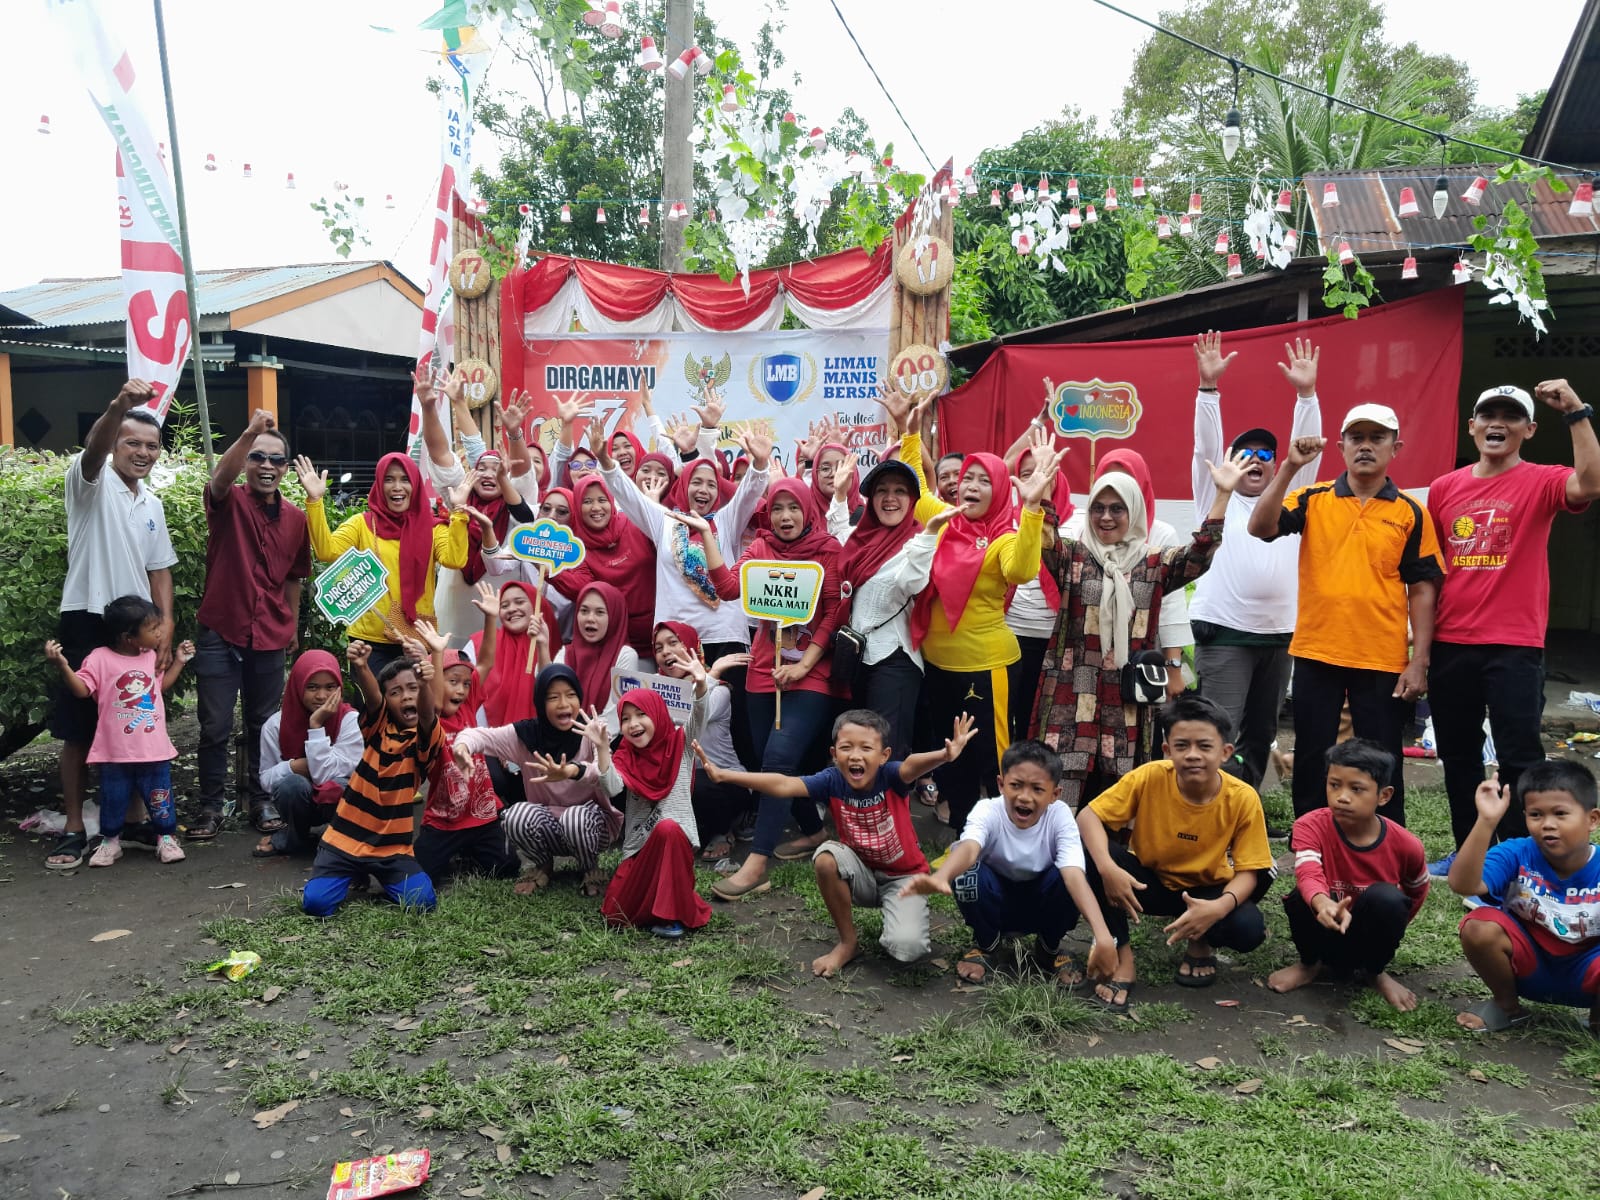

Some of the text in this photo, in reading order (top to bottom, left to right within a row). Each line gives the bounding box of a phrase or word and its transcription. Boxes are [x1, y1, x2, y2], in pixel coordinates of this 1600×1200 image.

[458, 257, 482, 290] 17
[823, 356, 877, 370] LIMAU
[545, 365, 657, 391] DIRGAHAYU
[766, 364, 798, 383] LMB
[823, 371, 877, 385] MANIS
[897, 354, 938, 394] 08
[1079, 404, 1130, 420] INDONESIA
[521, 535, 573, 552] INDONESIA
[527, 546, 565, 560] HEBAT!!!
[323, 558, 372, 605] DIRGAHAYU
[335, 571, 376, 612] NEGERIKU
[763, 584, 798, 599] NKRI
[749, 597, 809, 610] HARGA MATI
[651, 682, 681, 693] LIMAU
